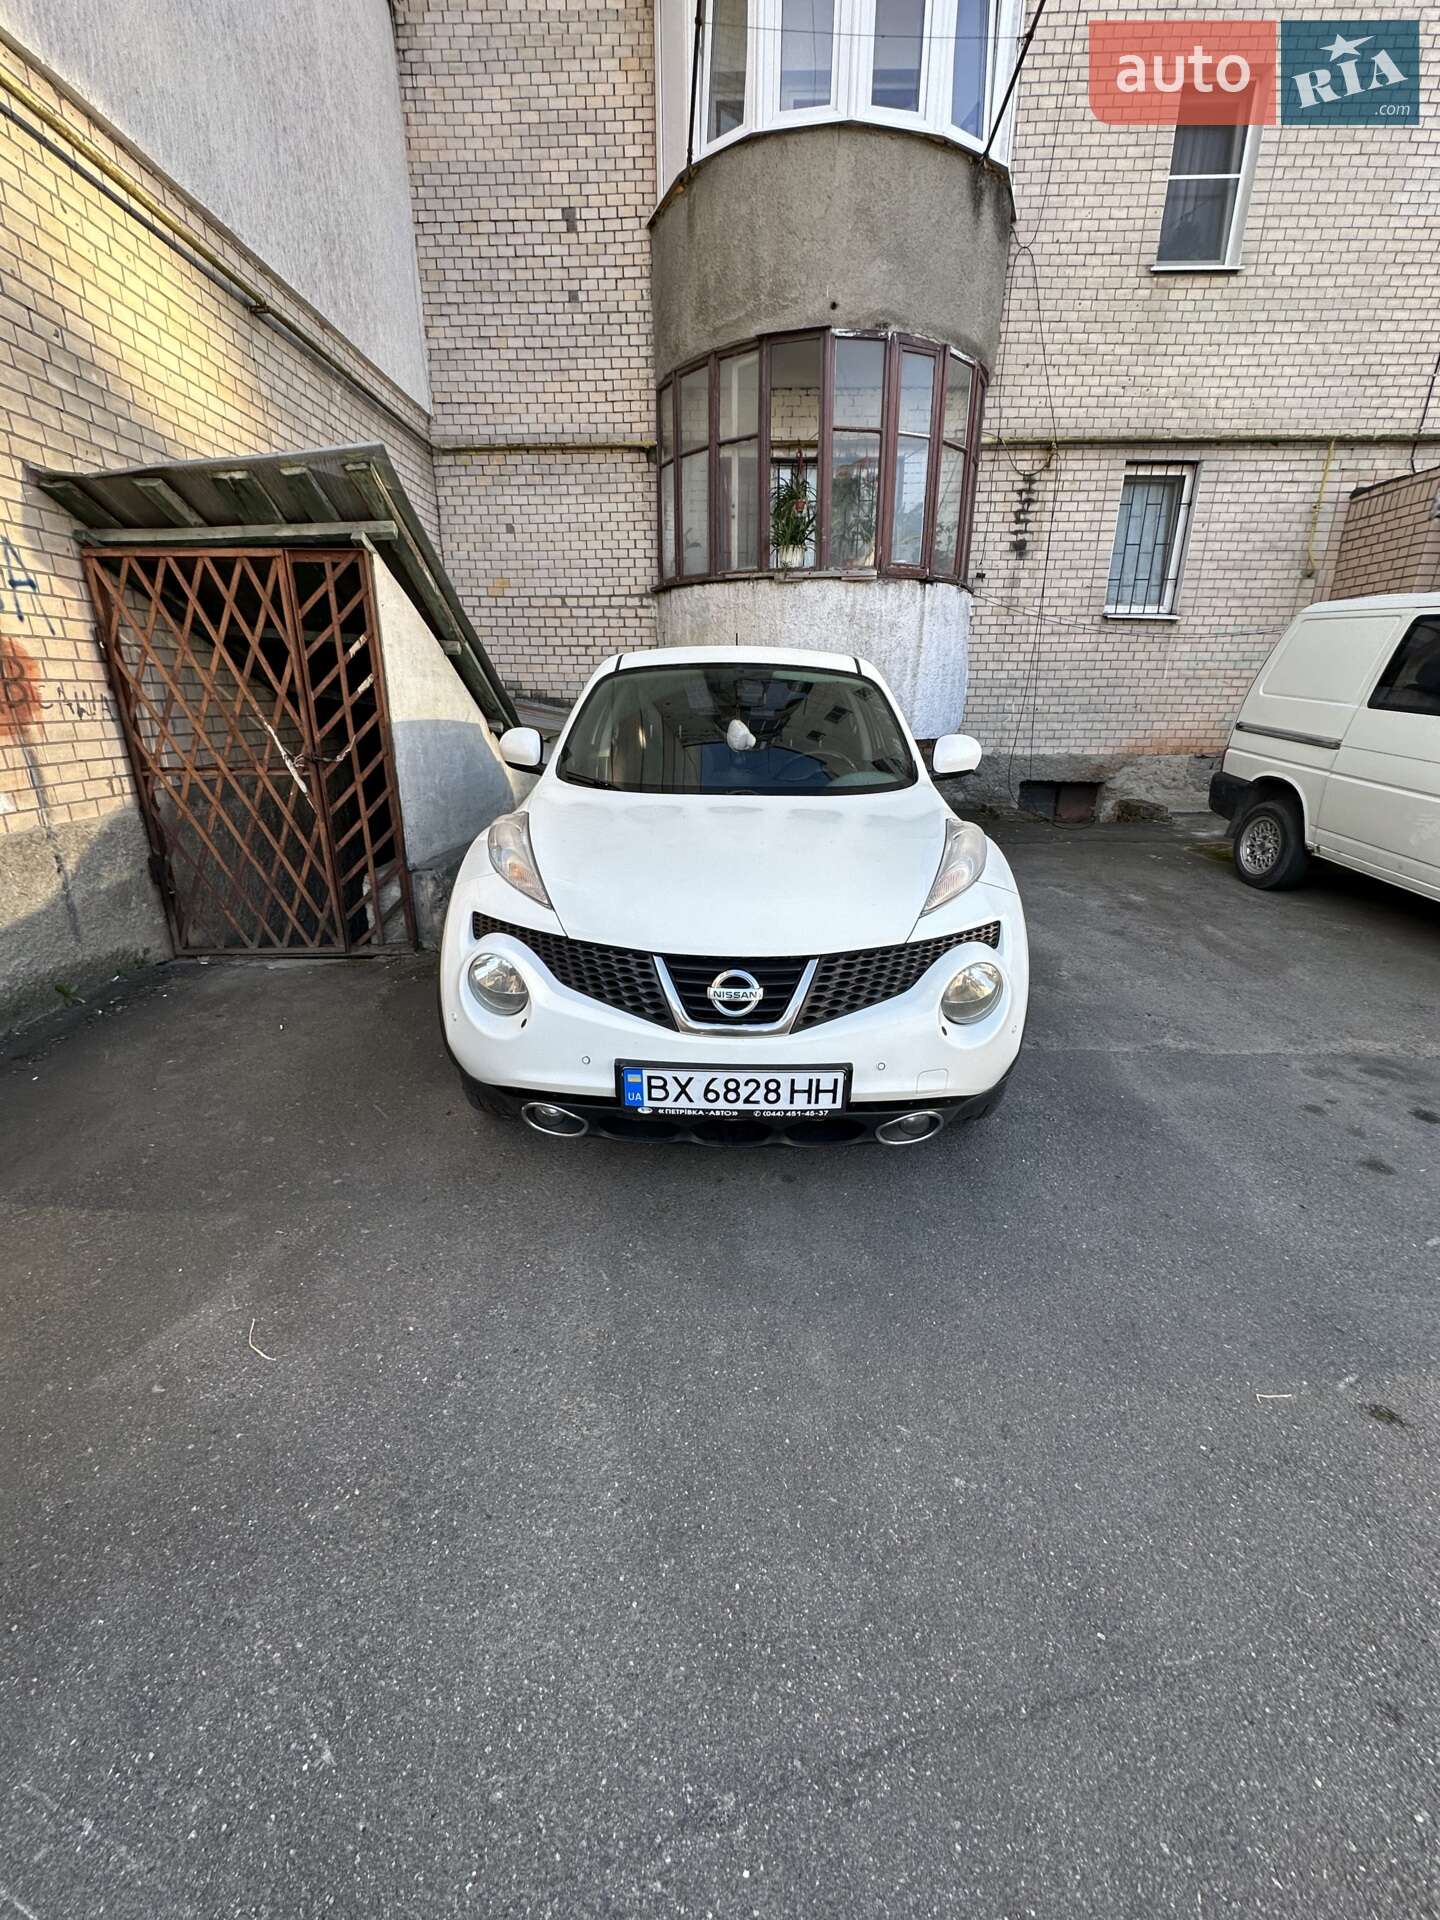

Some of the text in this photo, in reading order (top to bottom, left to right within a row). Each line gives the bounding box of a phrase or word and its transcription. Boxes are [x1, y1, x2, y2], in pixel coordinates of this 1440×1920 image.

[713, 990, 758, 1000] NISSAN
[703, 1077, 781, 1105] 6828
[628, 1092, 642, 1102] UA
